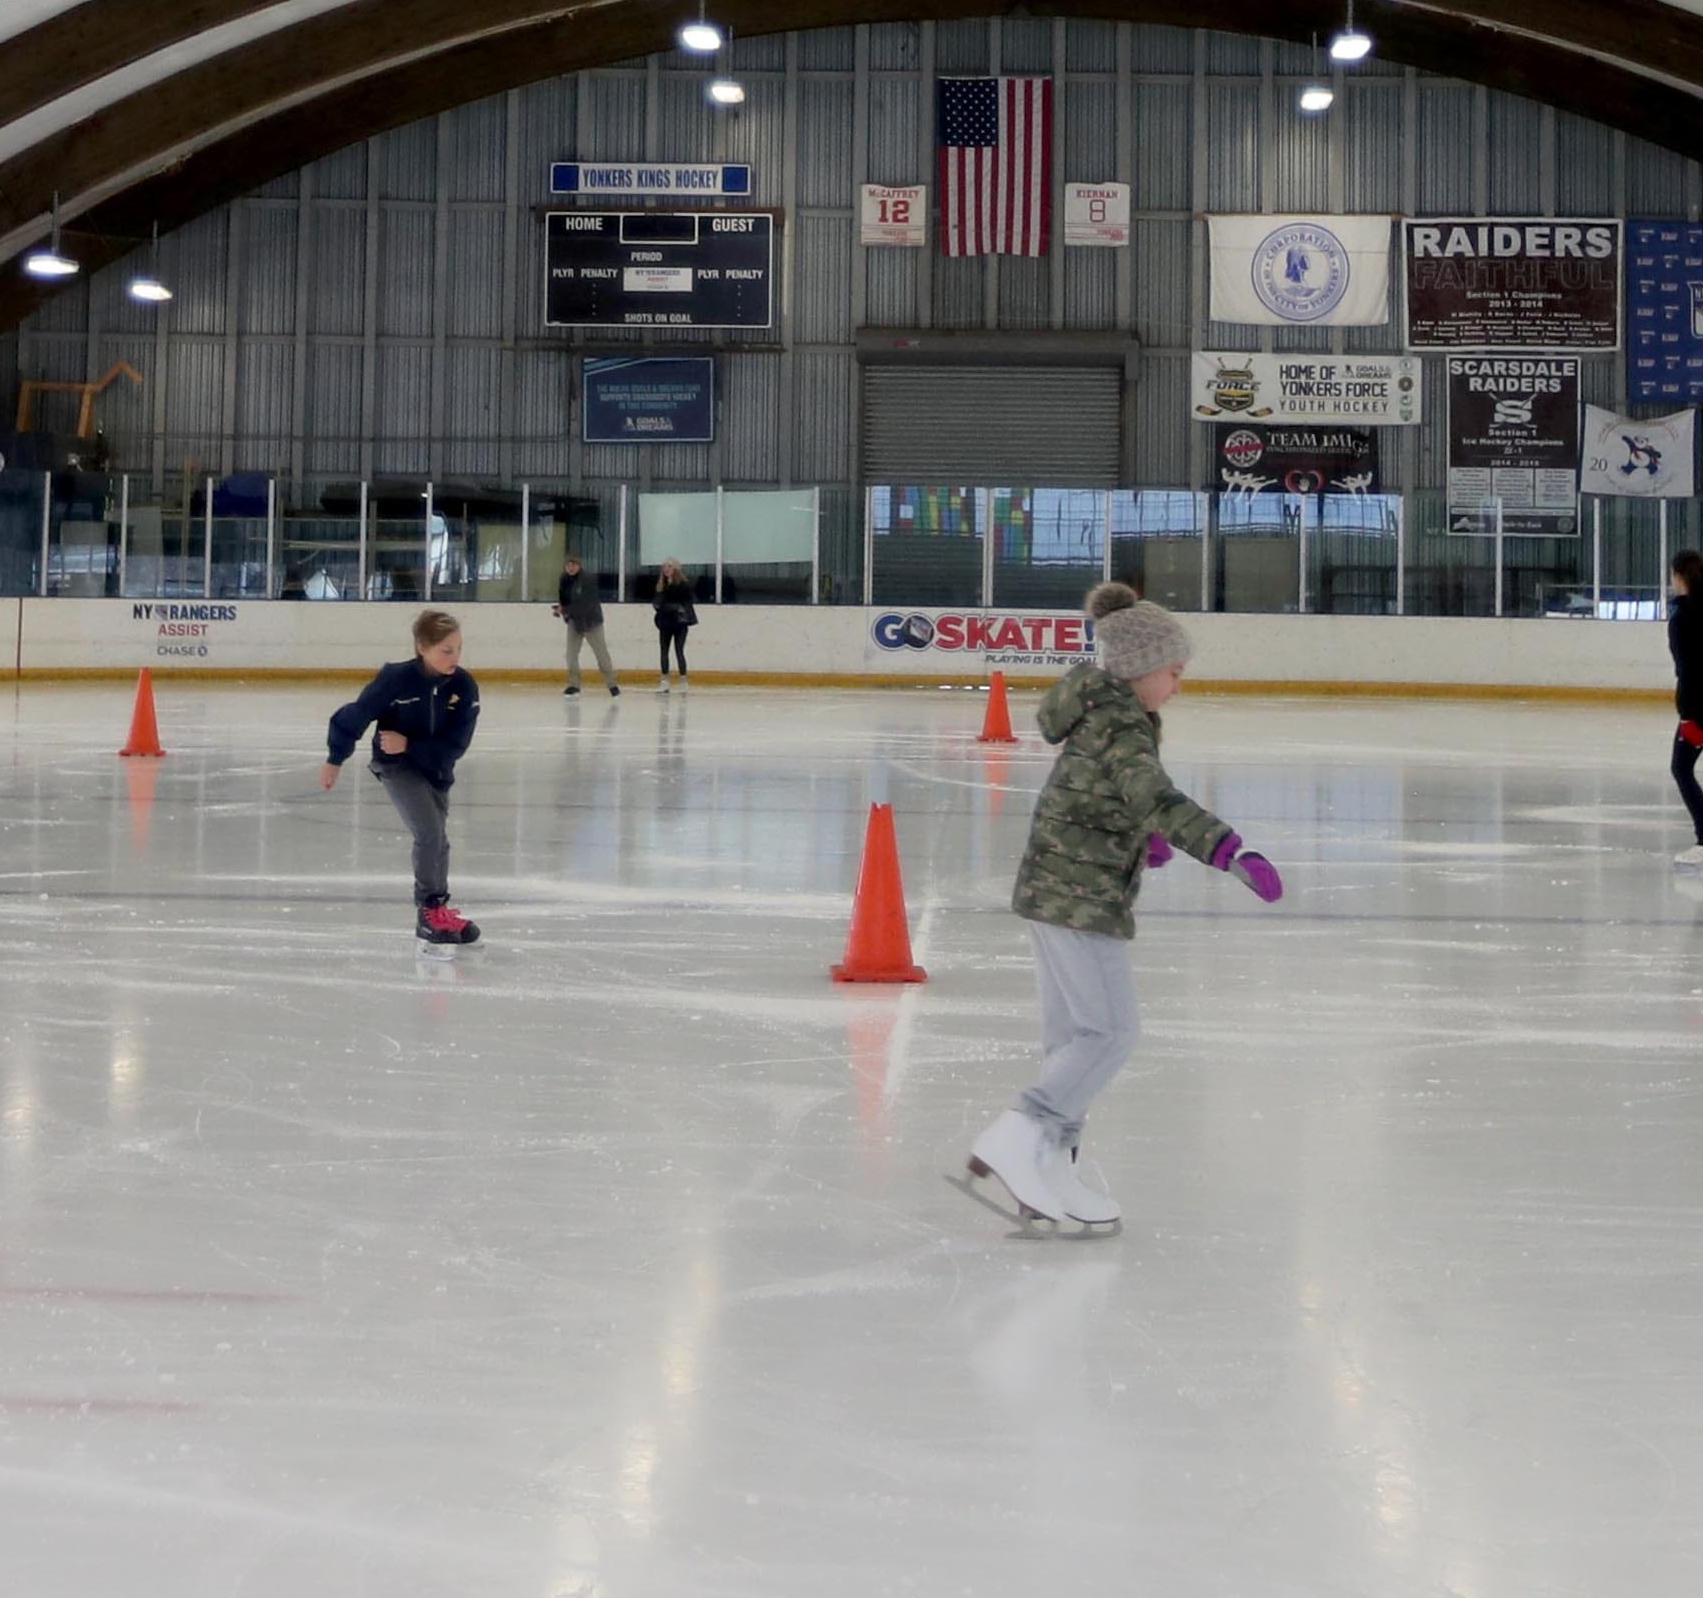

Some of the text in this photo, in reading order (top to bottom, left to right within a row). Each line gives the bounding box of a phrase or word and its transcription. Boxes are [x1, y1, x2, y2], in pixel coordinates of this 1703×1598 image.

[583, 169, 718, 189] YONKERS KINGS HOCKEY
[879, 199, 909, 223] 12
[1089, 199, 1105, 223] 8
[566, 217, 603, 231] HOME
[712, 218, 755, 232] GUEST
[1267, 233, 1336, 260] CORPORATION
[1413, 227, 1612, 258] RAIDERS
[631, 252, 662, 262] PERIOD
[553, 268, 618, 279] PLYR PENALTY
[697, 269, 763, 280] PLYR PENALTY
[1414, 259, 1614, 290] FAITHFUL
[1466, 291, 1562, 301] Section 1 Champions
[1520, 300, 1543, 308] 2014
[624, 313, 693, 324] SHOTS ON GOAL
[1279, 364, 1336, 380] HOME OF
[1451, 361, 1576, 377] SCARSDALE
[1206, 379, 1261, 391] FORCE
[1280, 382, 1388, 398] YONKERS FORCE
[1469, 378, 1561, 393] RAIDERS
[1279, 400, 1389, 413] YOUTH HOCKEY
[1267, 432, 1317, 446] TEAM
[1488, 429, 1528, 437] Section
[1479, 438, 1513, 446] Hockey
[1514, 439, 1564, 447] Champions
[1589, 457, 1608, 472] 20
[133, 603, 237, 621] NY RANGERS
[158, 624, 209, 637] ASSIST
[156, 645, 196, 656] CHASE
[985, 655, 1031, 664] PLAYING
[1033, 656, 1045, 664] IS
[1046, 656, 1066, 665] THE
